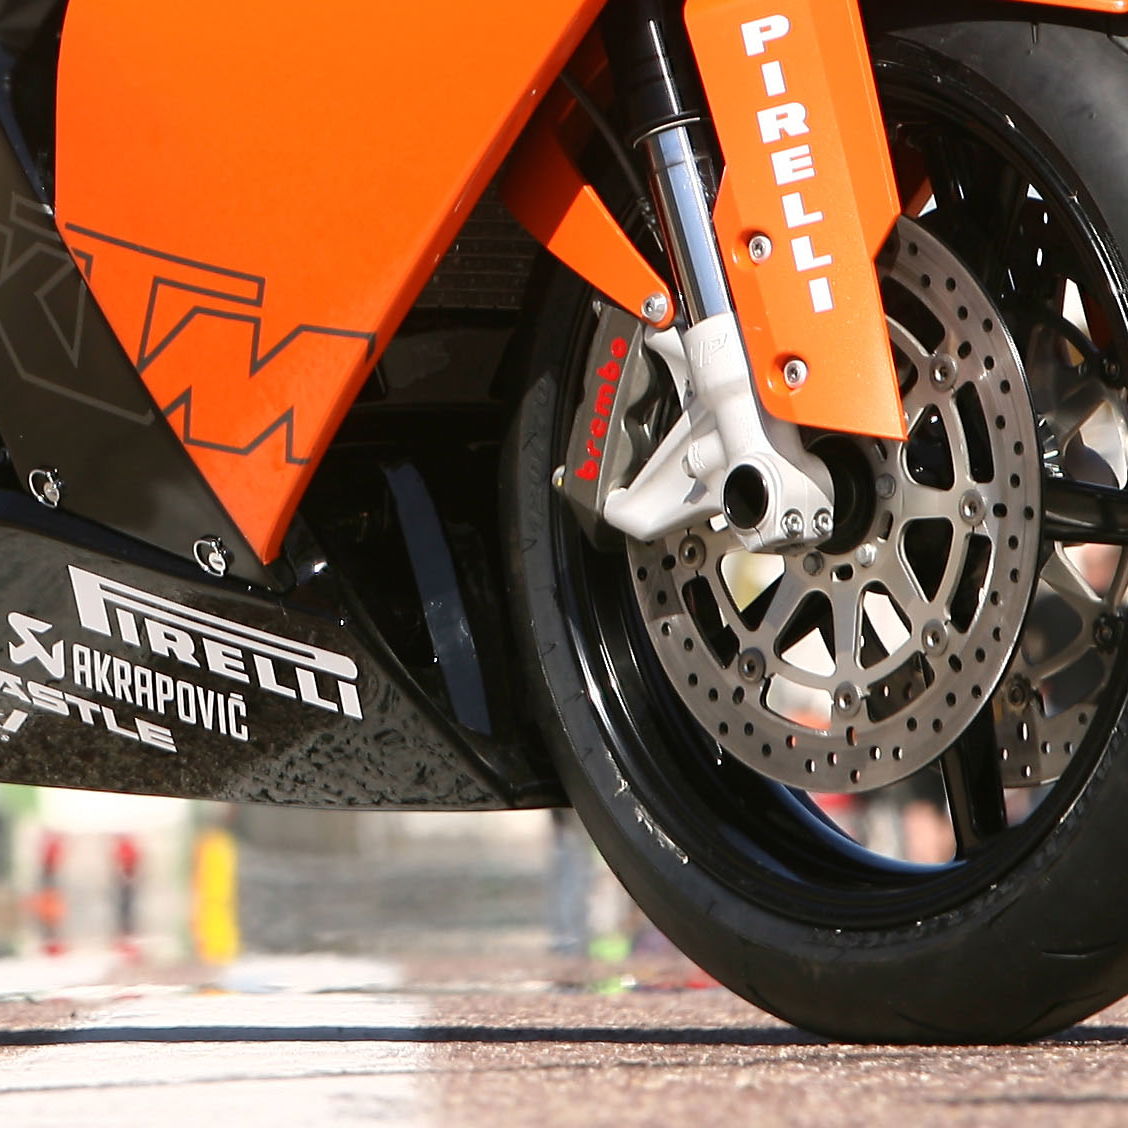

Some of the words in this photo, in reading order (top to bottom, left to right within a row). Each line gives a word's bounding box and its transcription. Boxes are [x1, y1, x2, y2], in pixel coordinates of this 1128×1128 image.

[740, 14, 834, 313] PIRELLI
[575, 336, 628, 481] brembo
[68, 565, 364, 720] PIRELLI
